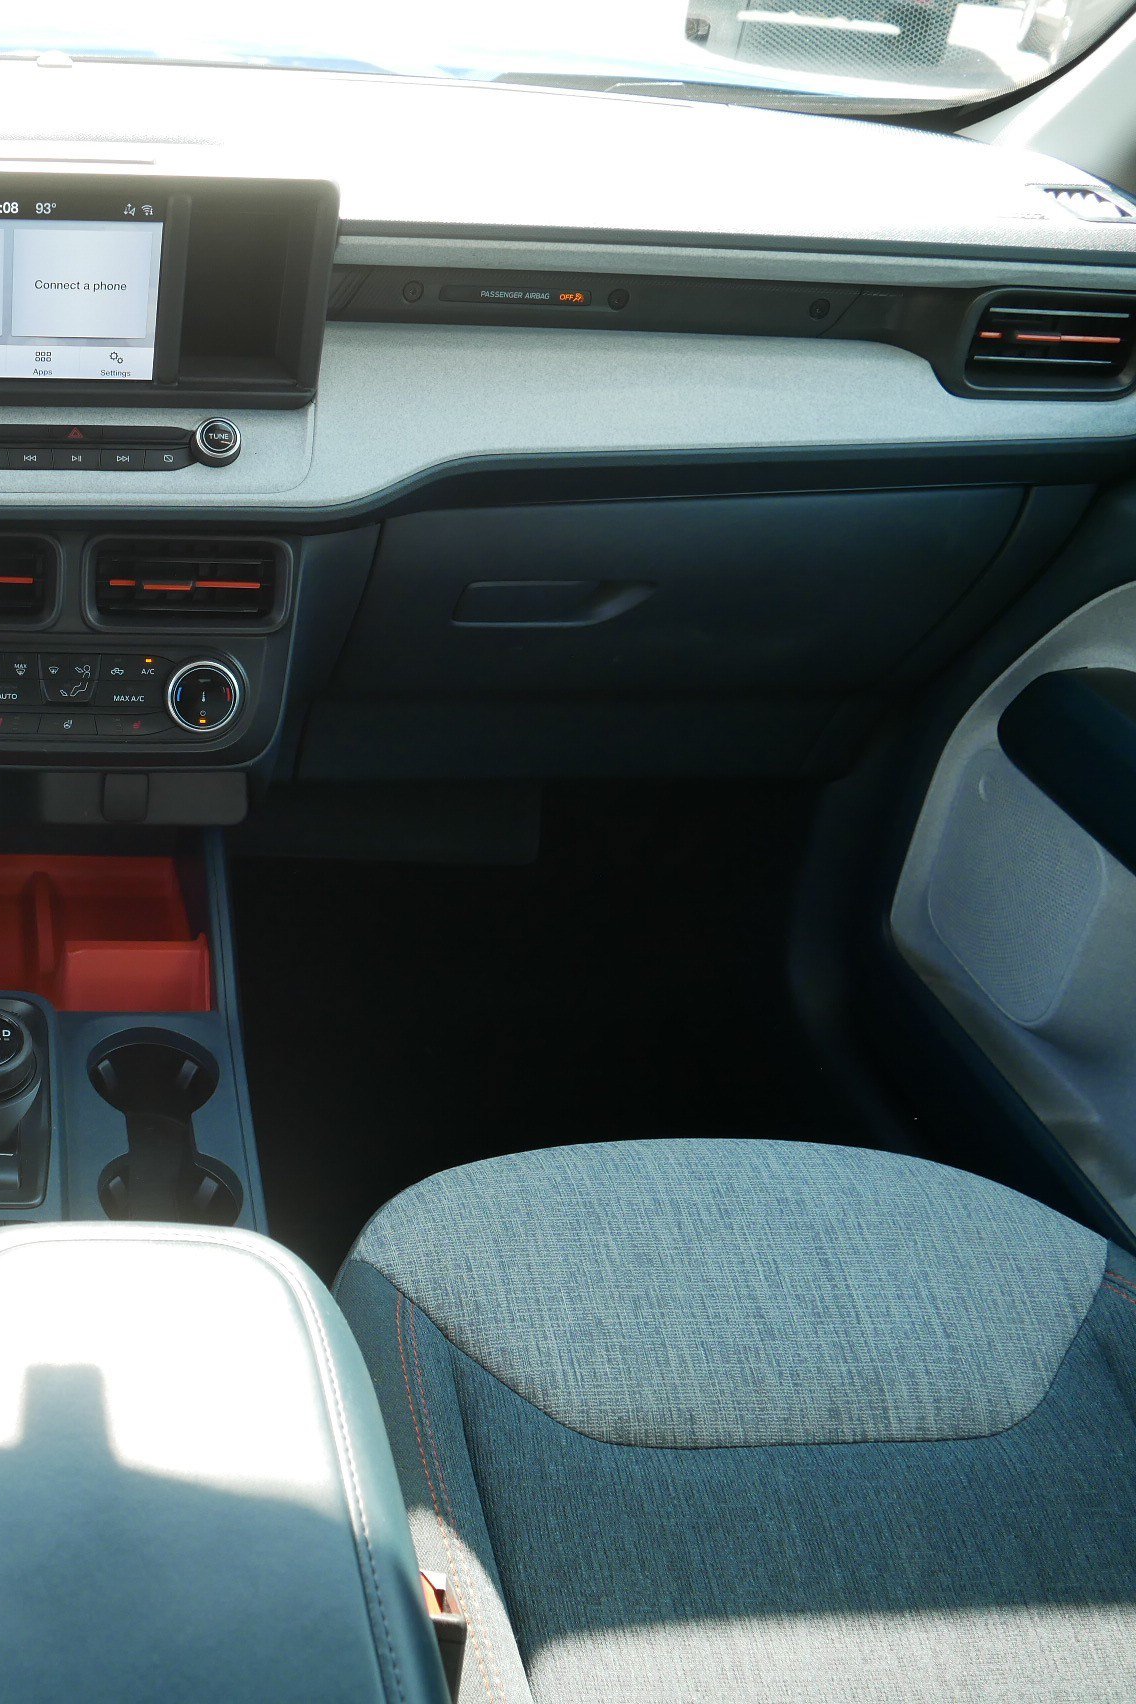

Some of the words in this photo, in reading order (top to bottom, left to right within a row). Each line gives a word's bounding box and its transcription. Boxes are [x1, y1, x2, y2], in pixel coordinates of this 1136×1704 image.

[35, 202, 57, 214] 93°
[34, 279, 80, 290] Connect
[83, 282, 90, 290] a
[93, 281, 127, 292] phone
[480, 290, 523, 299] PASSENGER
[524, 292, 550, 300] AIRBAG
[559, 293, 574, 301] OFF
[32, 368, 53, 377] Apps
[100, 369, 131, 379] Settings
[113, 694, 130, 702] MAX
[2, 1029, 11, 1037] D
